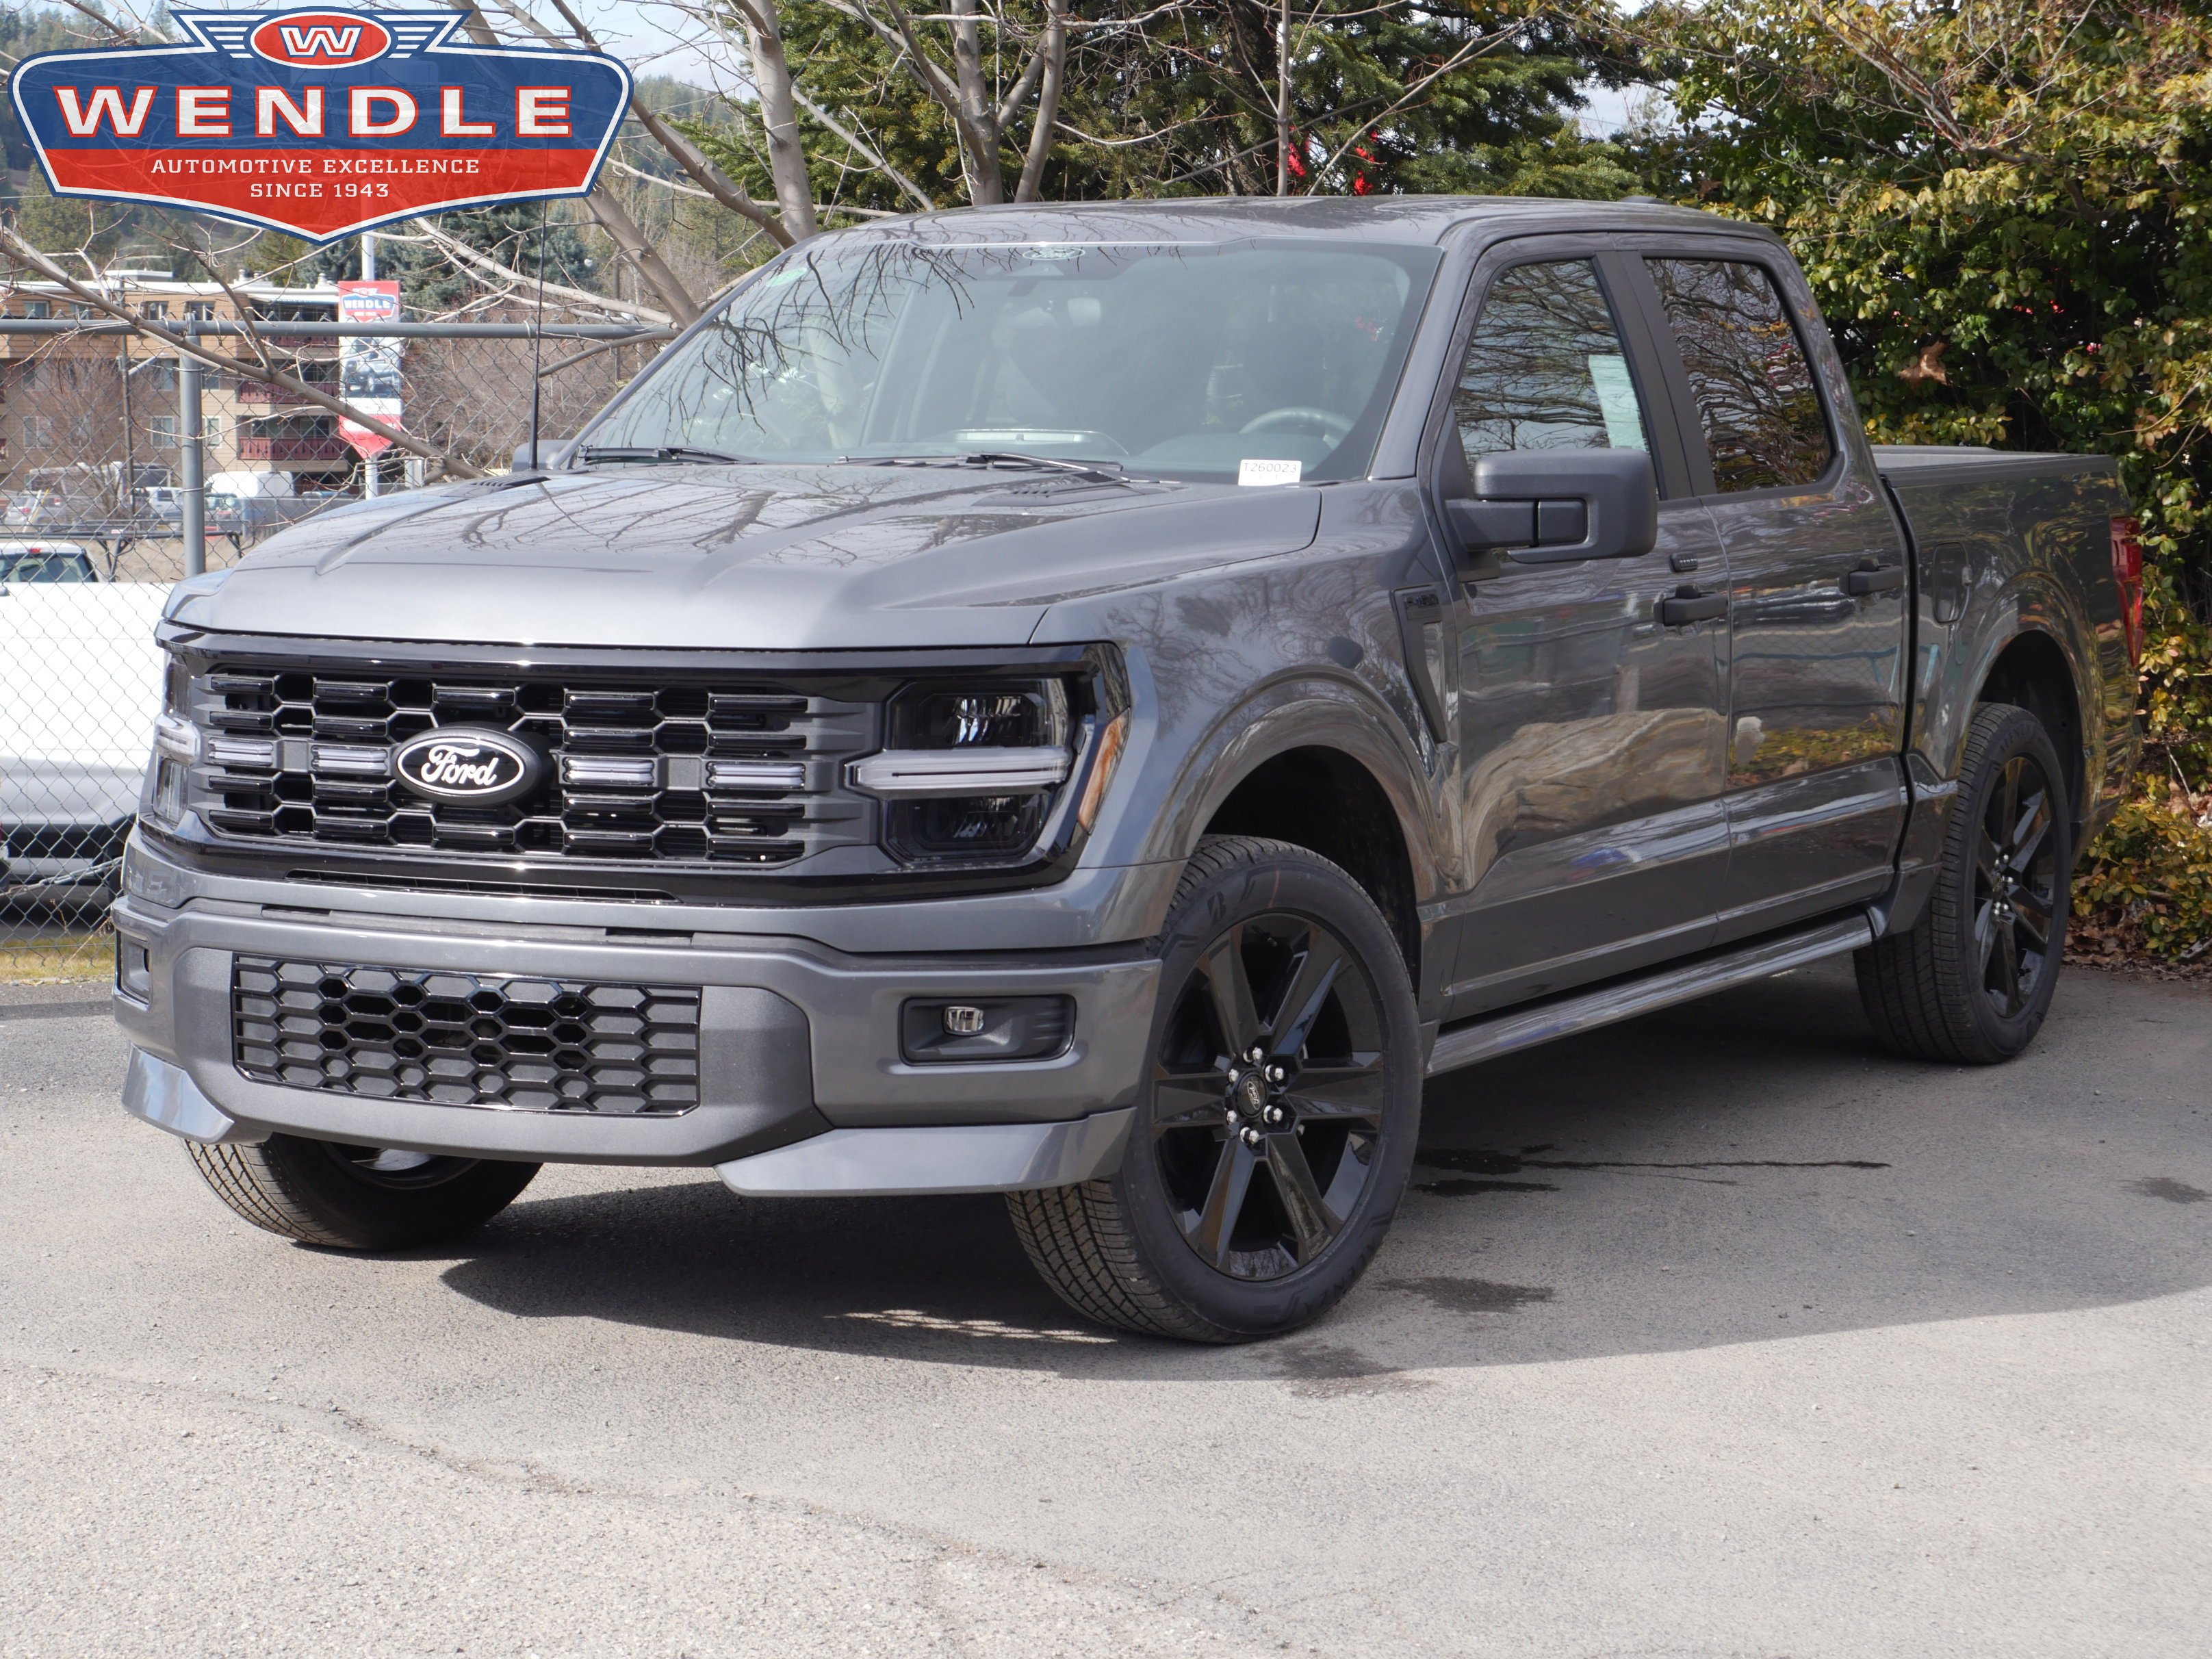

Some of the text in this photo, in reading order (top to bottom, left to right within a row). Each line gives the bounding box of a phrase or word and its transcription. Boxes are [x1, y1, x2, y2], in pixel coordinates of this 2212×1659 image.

[344, 300, 390, 309] WENDLE
[1243, 462, 1297, 473] T260023
[421, 745, 499, 786] Ford
